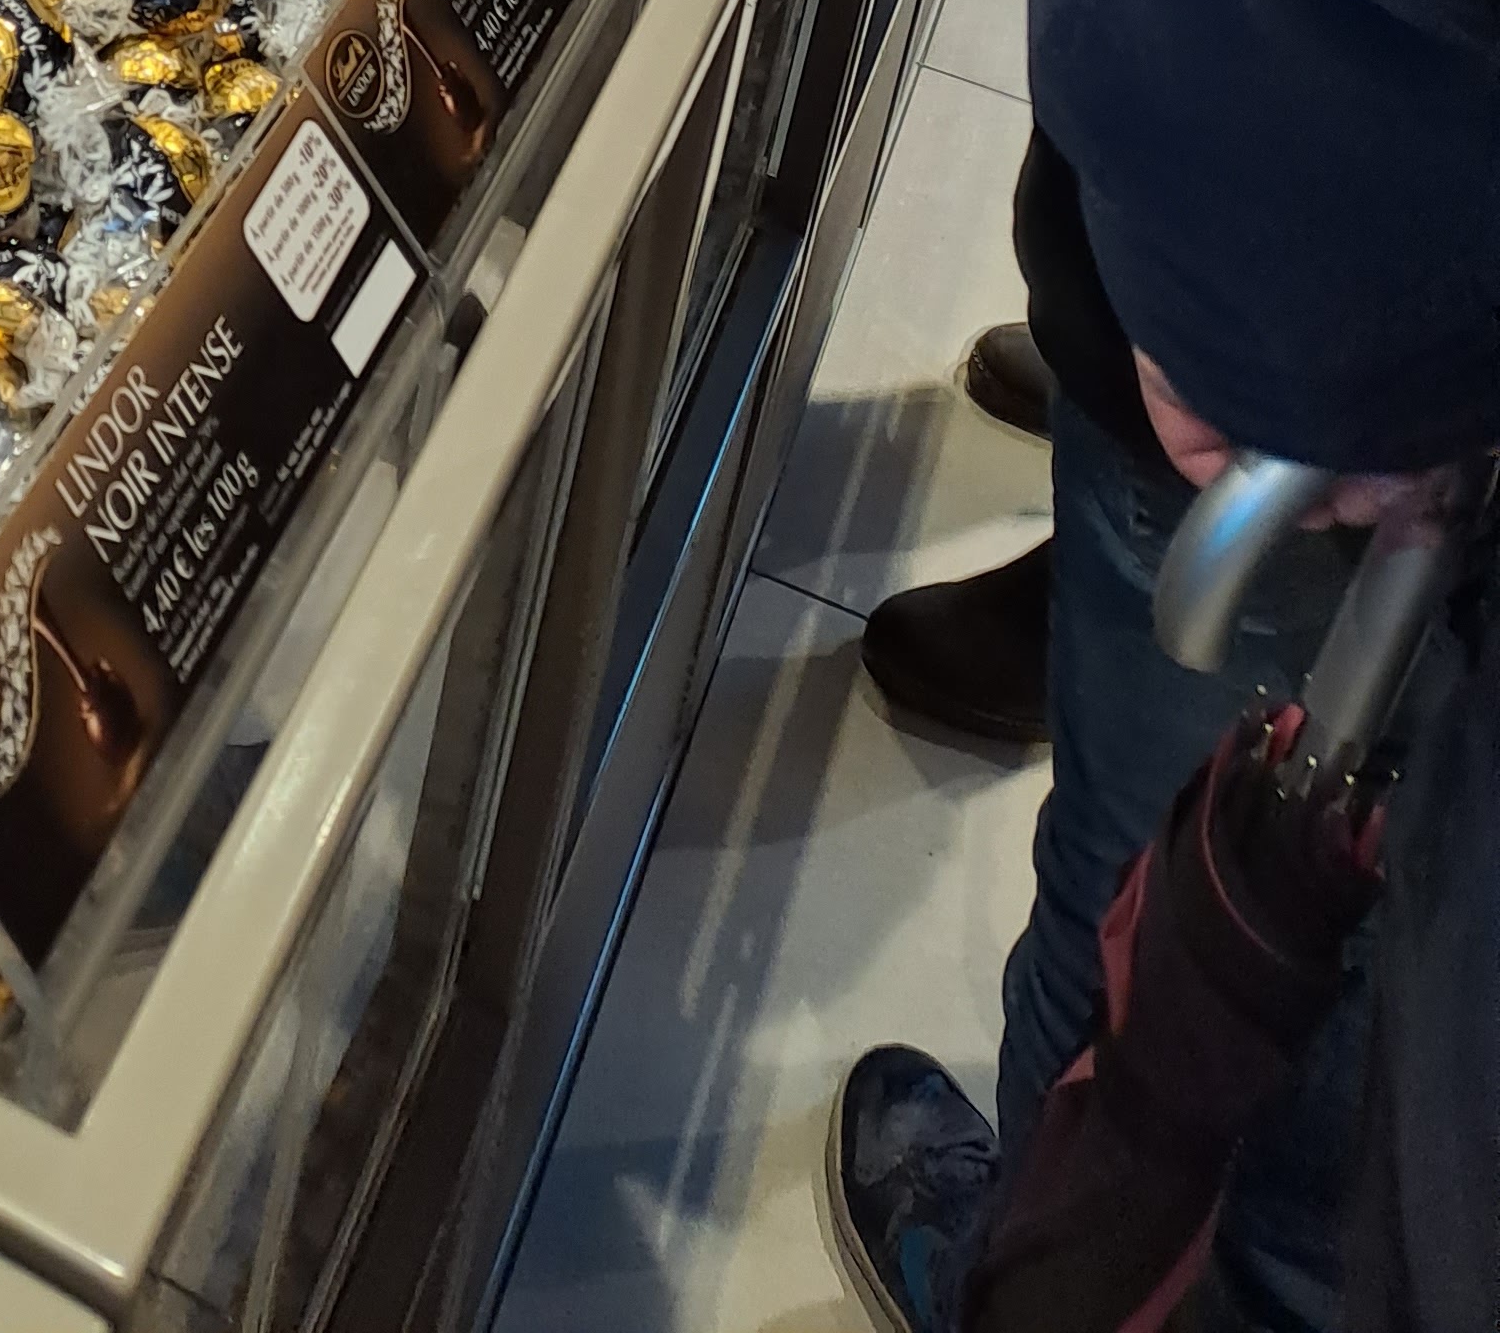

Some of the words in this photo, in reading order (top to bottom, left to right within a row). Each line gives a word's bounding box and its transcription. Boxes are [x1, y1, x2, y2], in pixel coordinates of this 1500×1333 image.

[344, 59, 378, 109] LINDOR
[53, 356, 162, 524] LINDOR
[81, 439, 163, 570] NOIR
[143, 312, 244, 470] INTENSE
[179, 499, 219, 566] les
